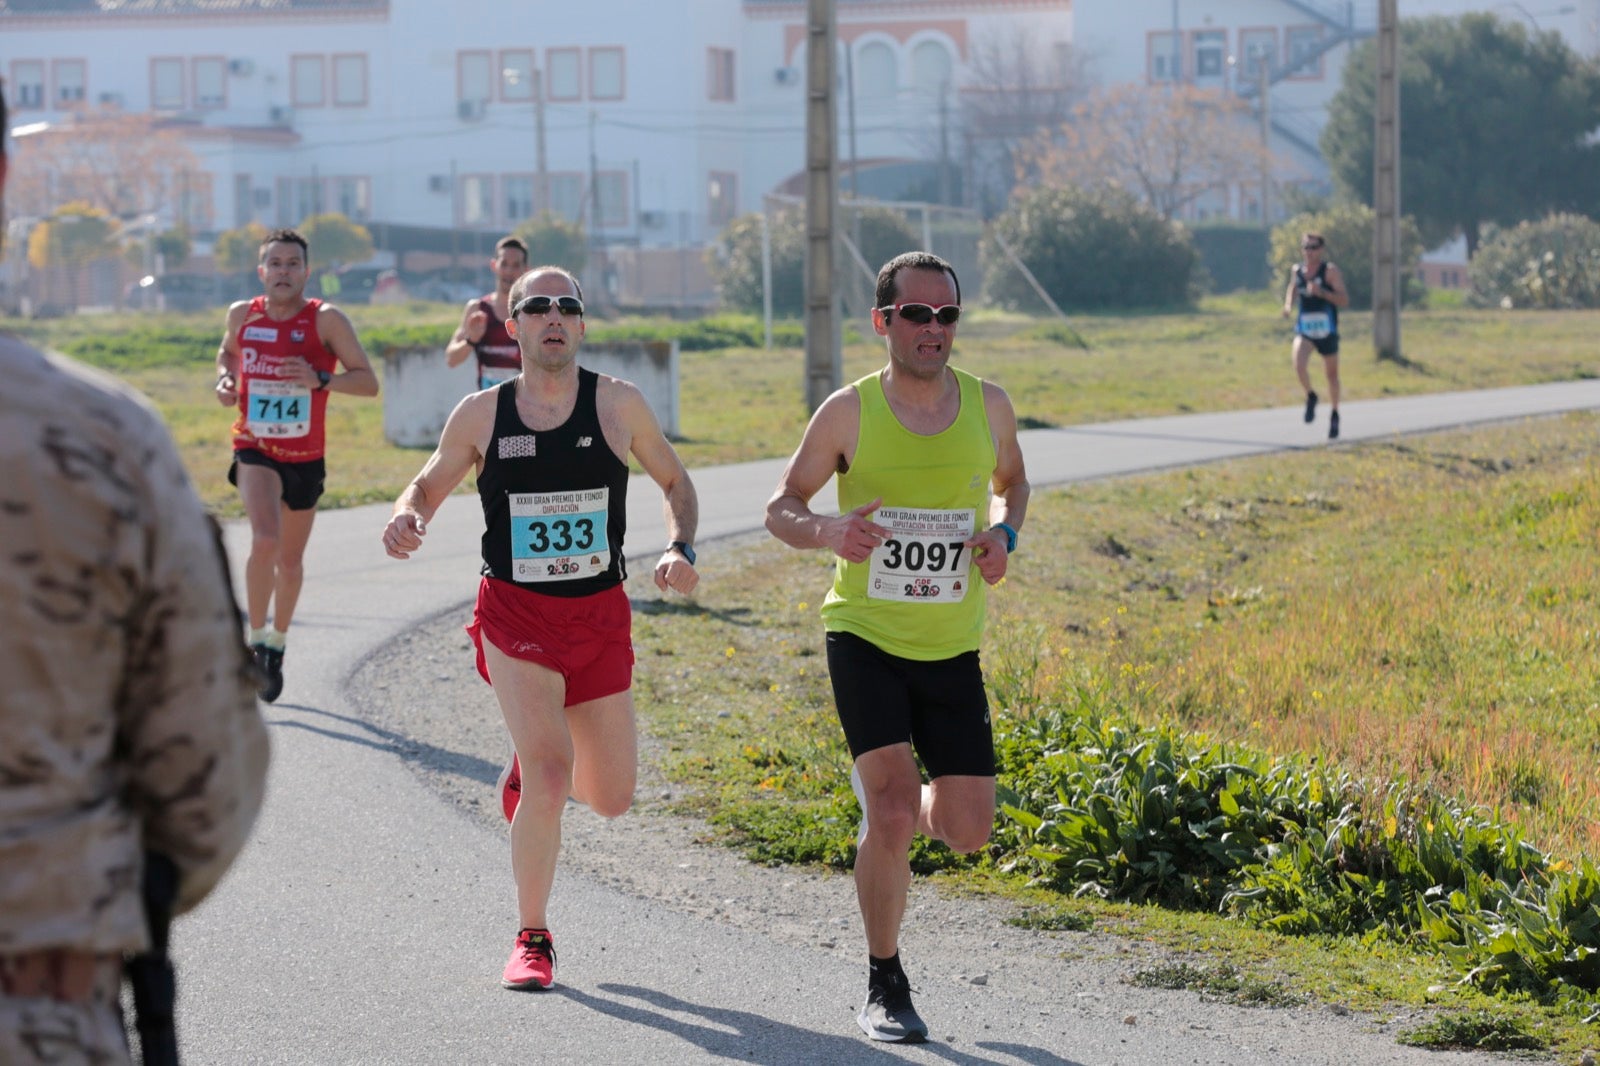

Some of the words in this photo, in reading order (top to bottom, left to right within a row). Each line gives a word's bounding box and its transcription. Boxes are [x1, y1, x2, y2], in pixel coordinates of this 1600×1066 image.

[258, 399, 300, 419] 714
[516, 496, 533, 504] XXXIII
[534, 496, 550, 504] GRAN
[552, 494, 574, 503] PREMIO
[575, 493, 583, 502] DE
[584, 491, 604, 501] FONDO
[880, 511, 898, 519] XXXIII
[899, 512, 917, 521] GRAN
[919, 513, 941, 522] PREMIO
[943, 513, 951, 522] DE
[951, 513, 969, 521] FONDO
[927, 522, 934, 530] DE
[935, 522, 959, 530] GRANADA
[528, 518, 594, 553] 333
[883, 539, 965, 572] 3097
